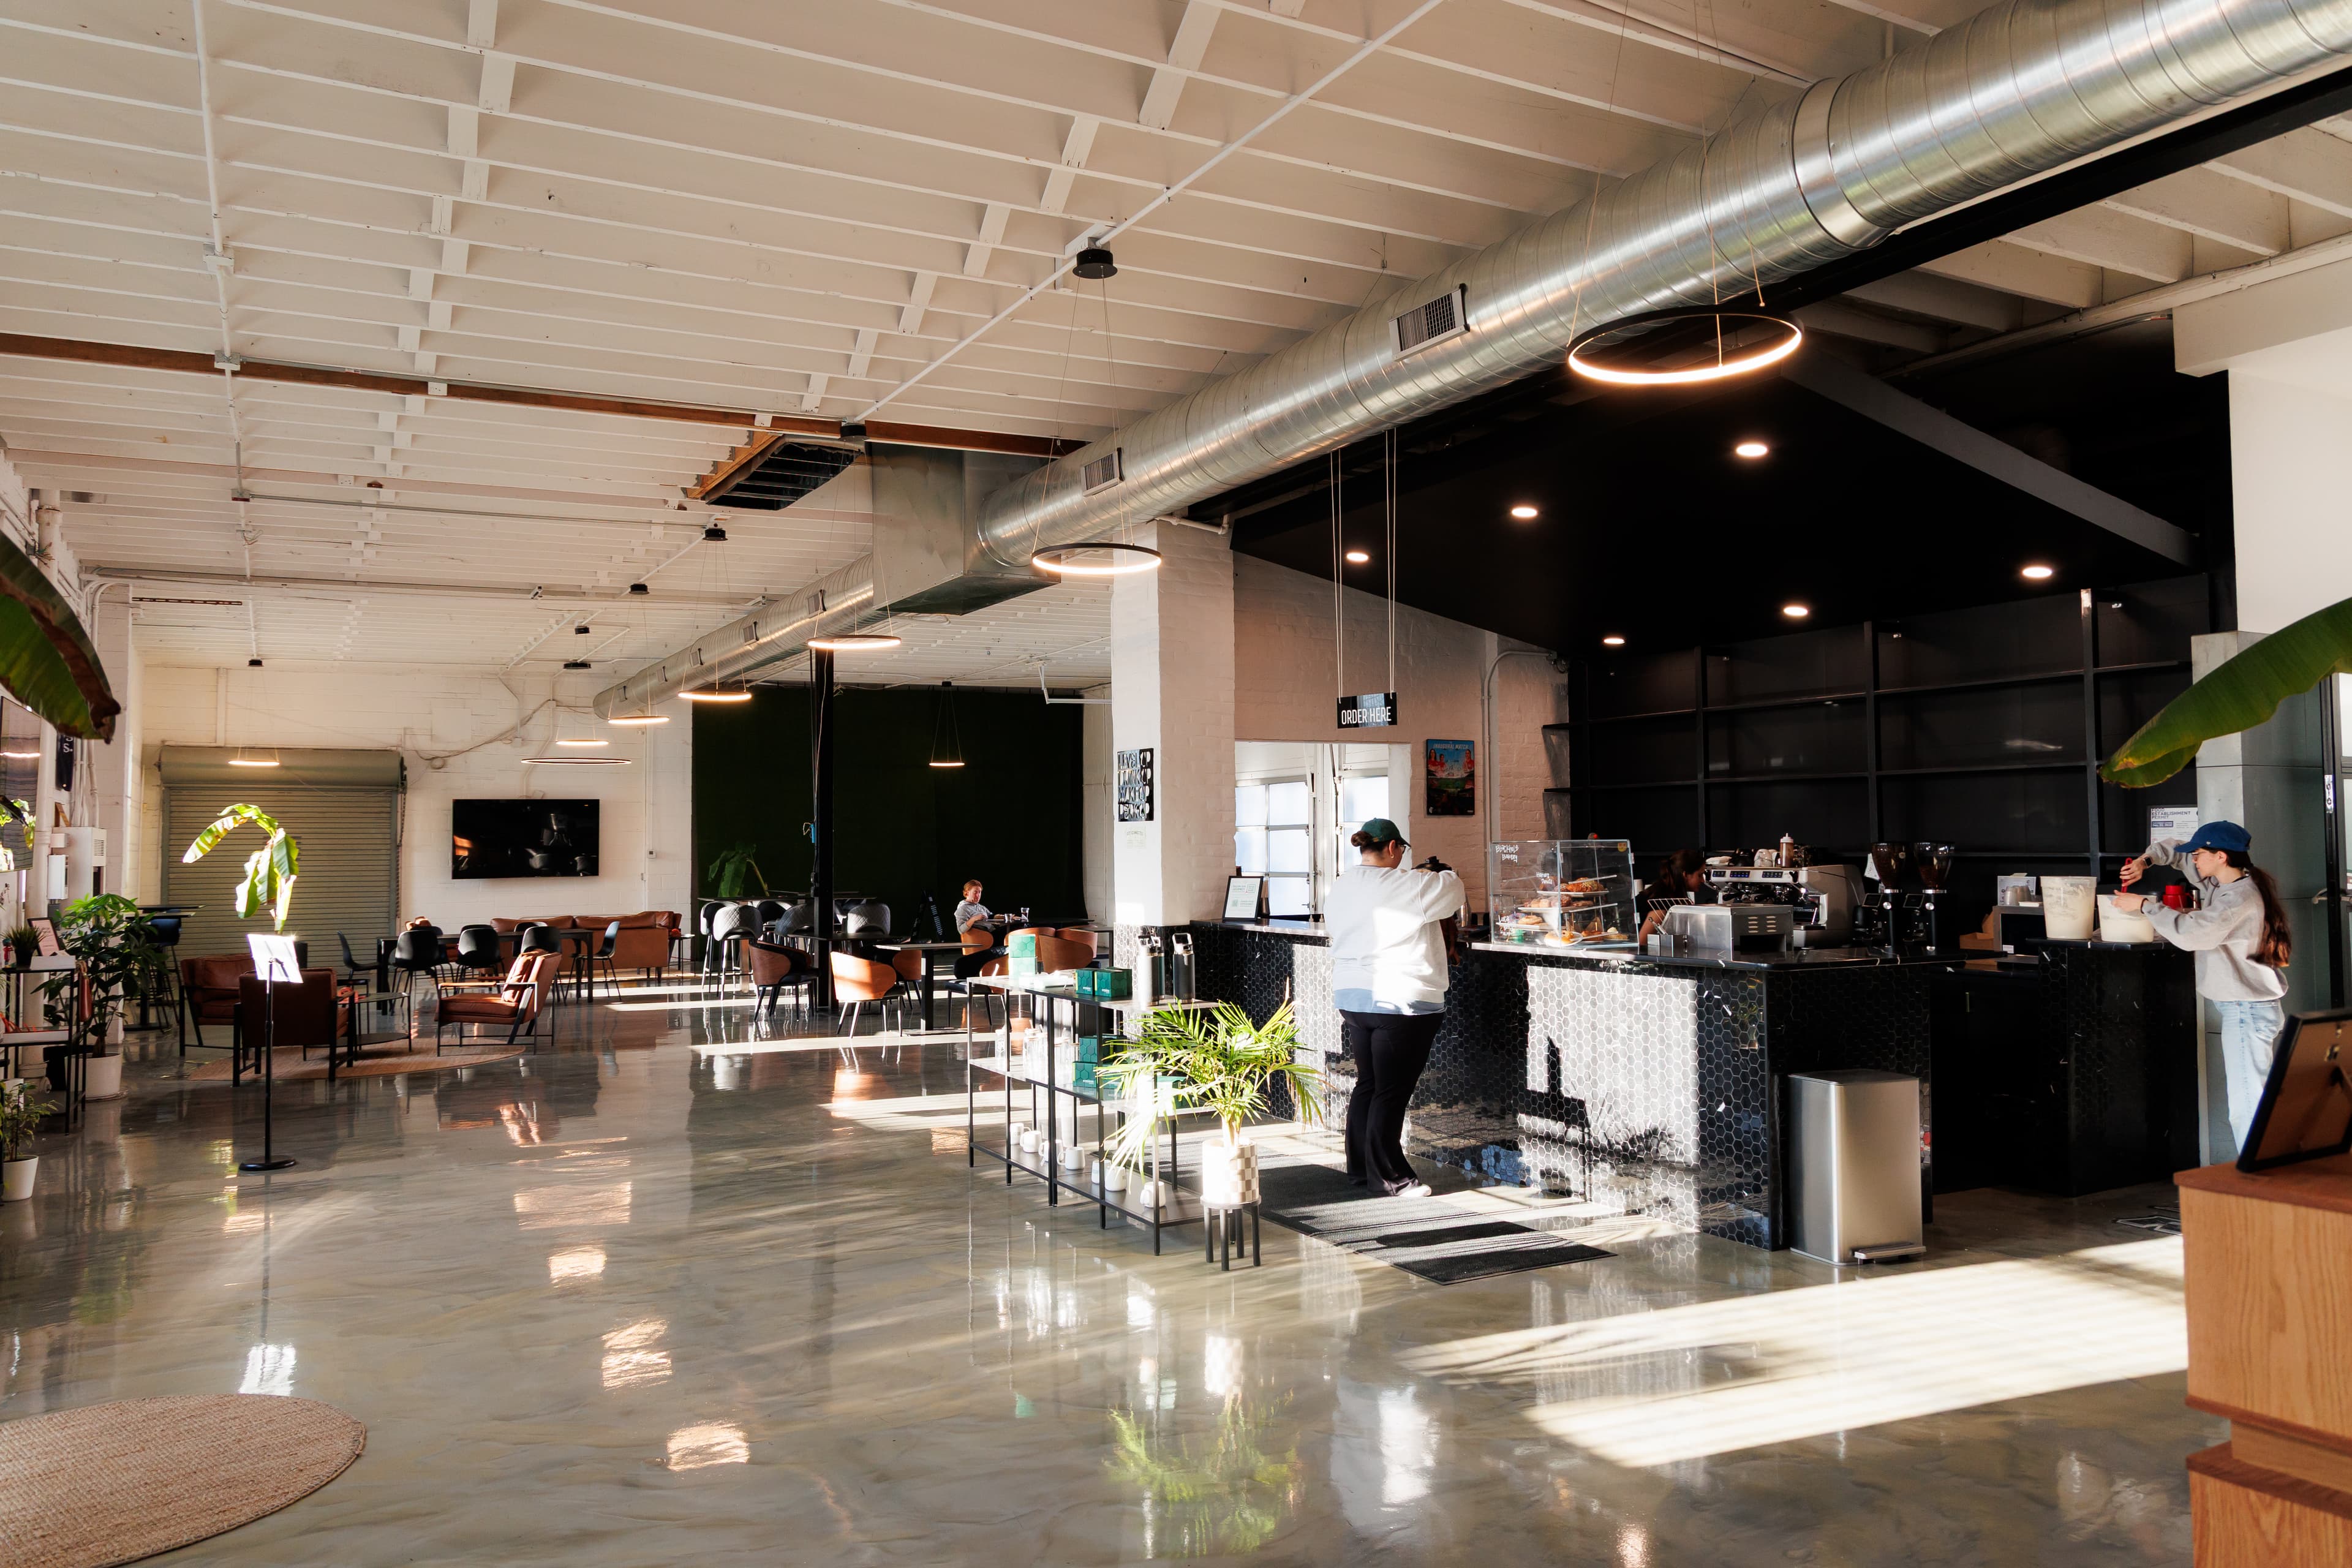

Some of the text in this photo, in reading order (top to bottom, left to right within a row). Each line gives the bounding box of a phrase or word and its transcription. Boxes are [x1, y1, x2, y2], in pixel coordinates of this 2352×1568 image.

[1341, 706, 1392, 725] ORDER HERE
[1118, 751, 1151, 768] LEVEL UP
[1141, 768, 1152, 784] UP
[1118, 785, 1150, 803] WAKE UP
[1139, 802, 1150, 819] UP
